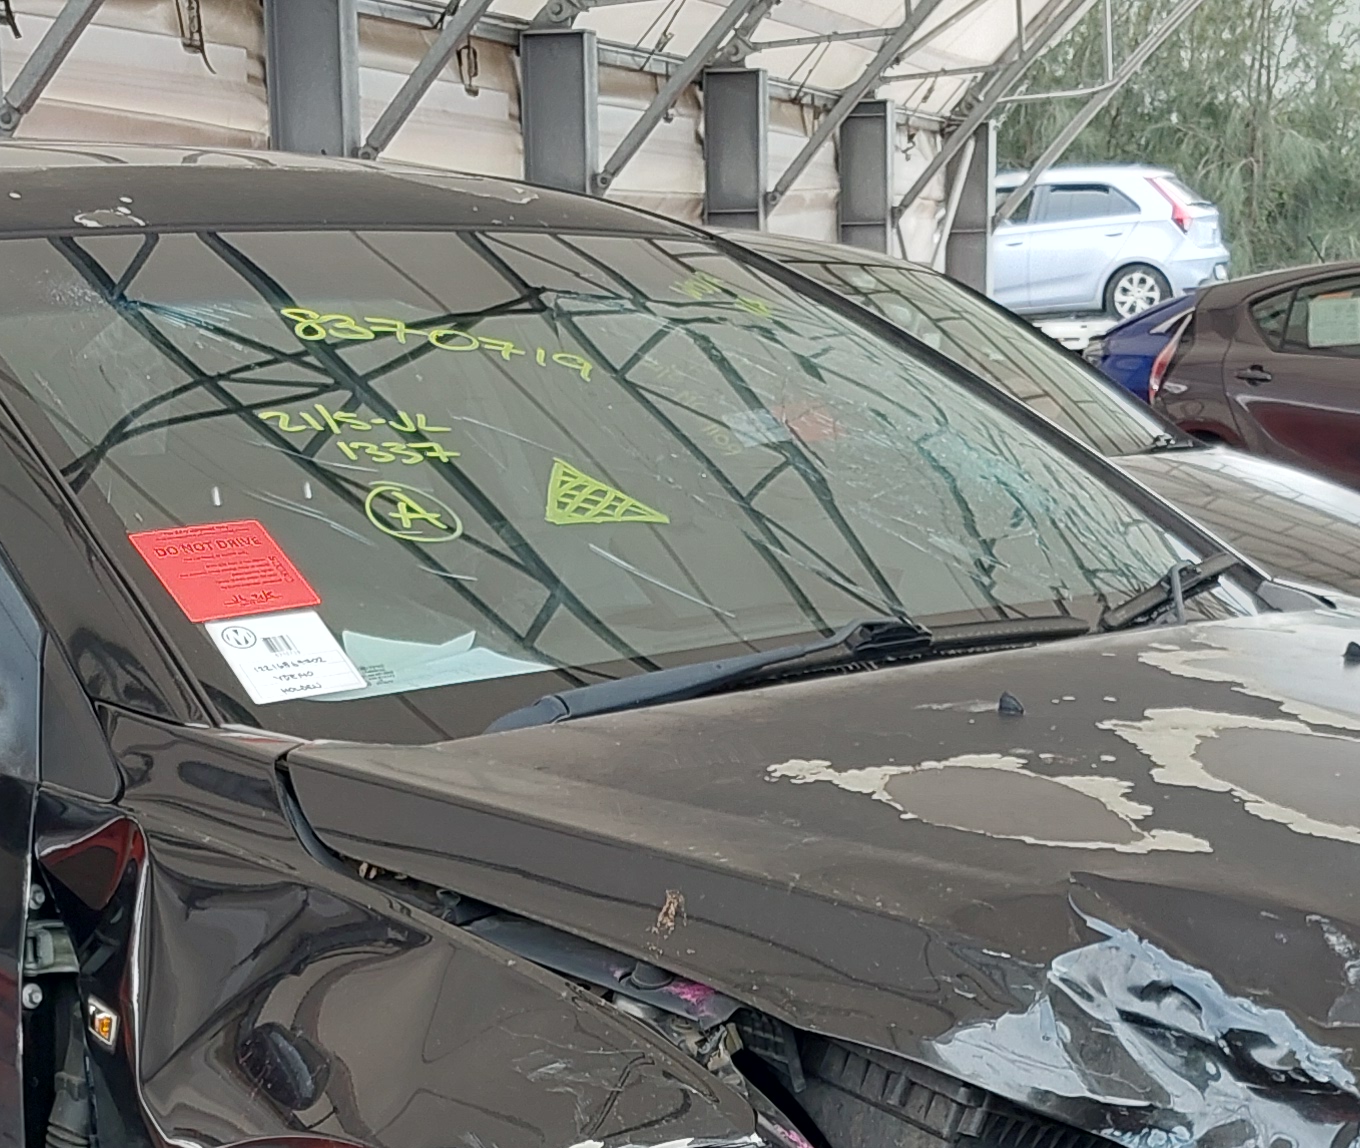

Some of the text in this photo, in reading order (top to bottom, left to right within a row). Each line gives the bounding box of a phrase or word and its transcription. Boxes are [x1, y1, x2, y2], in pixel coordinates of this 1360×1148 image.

[281, 308, 593, 383] 8370719
[153, 546, 179, 558] DO
[181, 541, 214, 554] NOT
[215, 536, 262, 549] DRIVE
